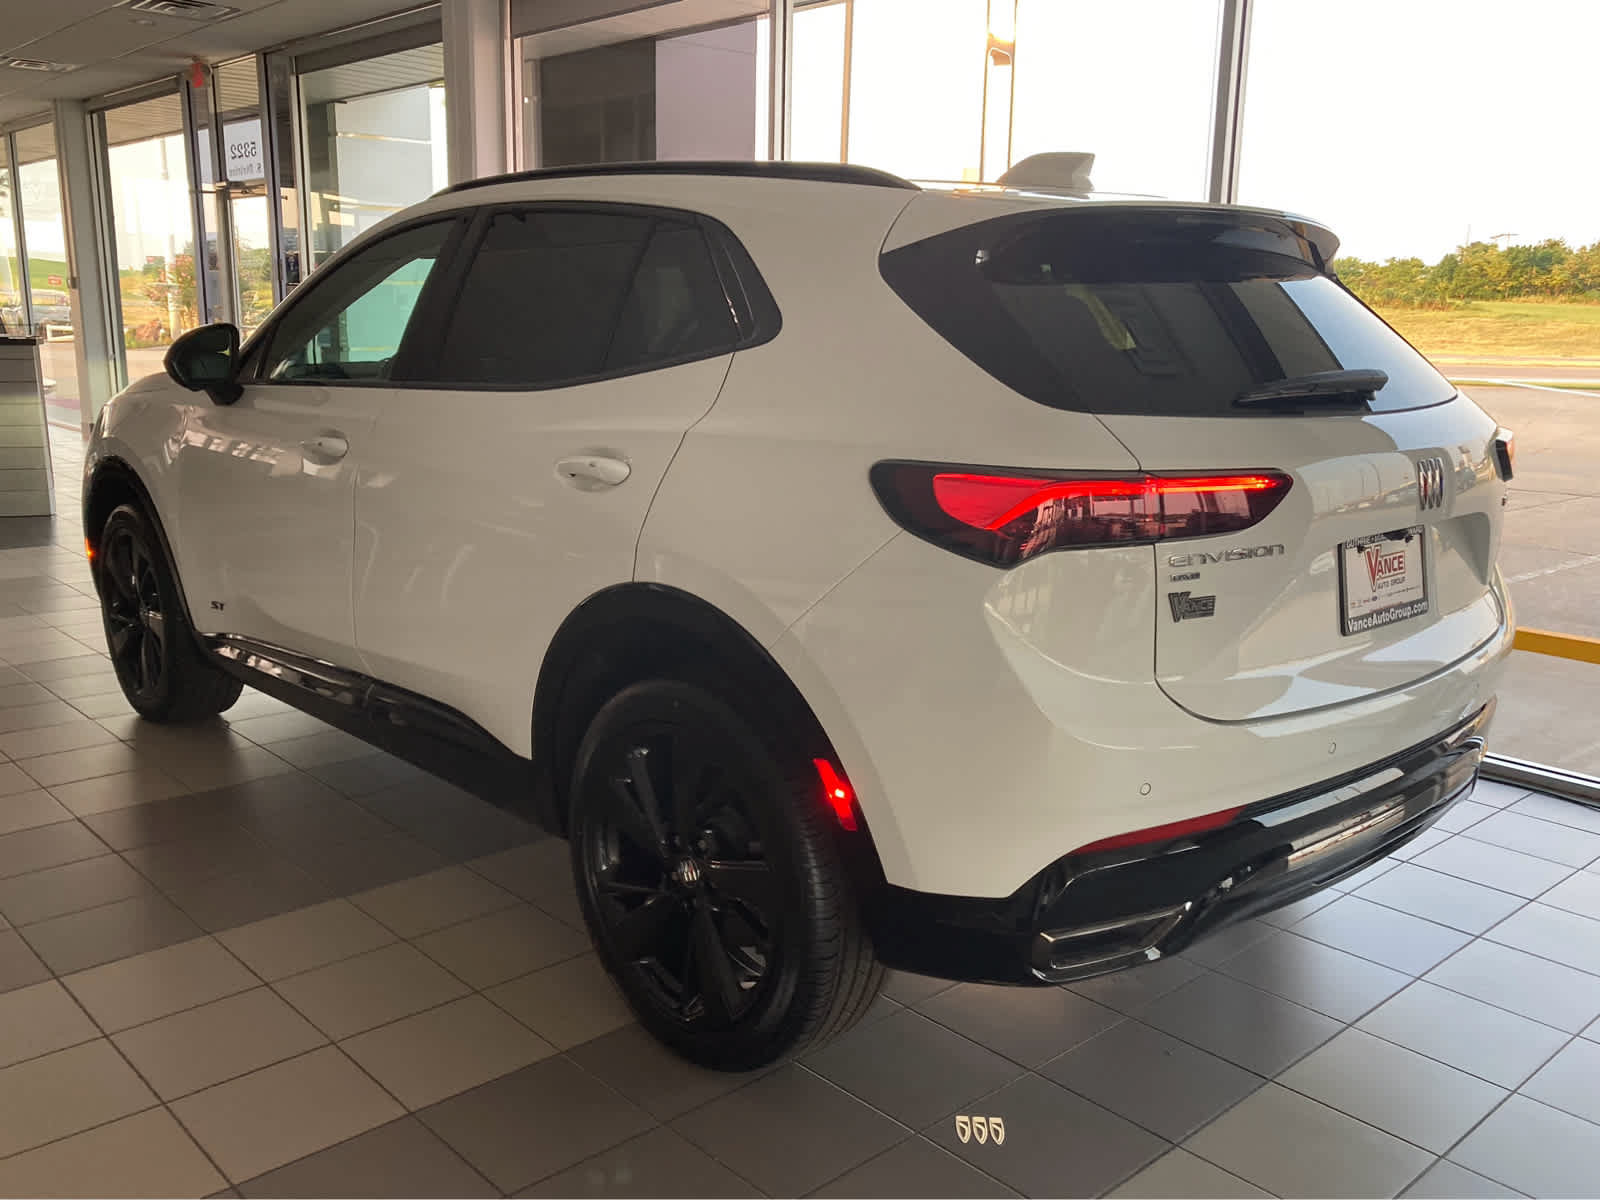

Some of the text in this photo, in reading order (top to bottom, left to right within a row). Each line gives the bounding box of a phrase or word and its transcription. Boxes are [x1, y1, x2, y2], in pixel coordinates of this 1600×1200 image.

[1168, 544, 1284, 568] ENVISION
[1364, 545, 1405, 592] VANCE
[211, 601, 224, 611] ST
[1348, 602, 1428, 632] VanceAutoGroup.com
